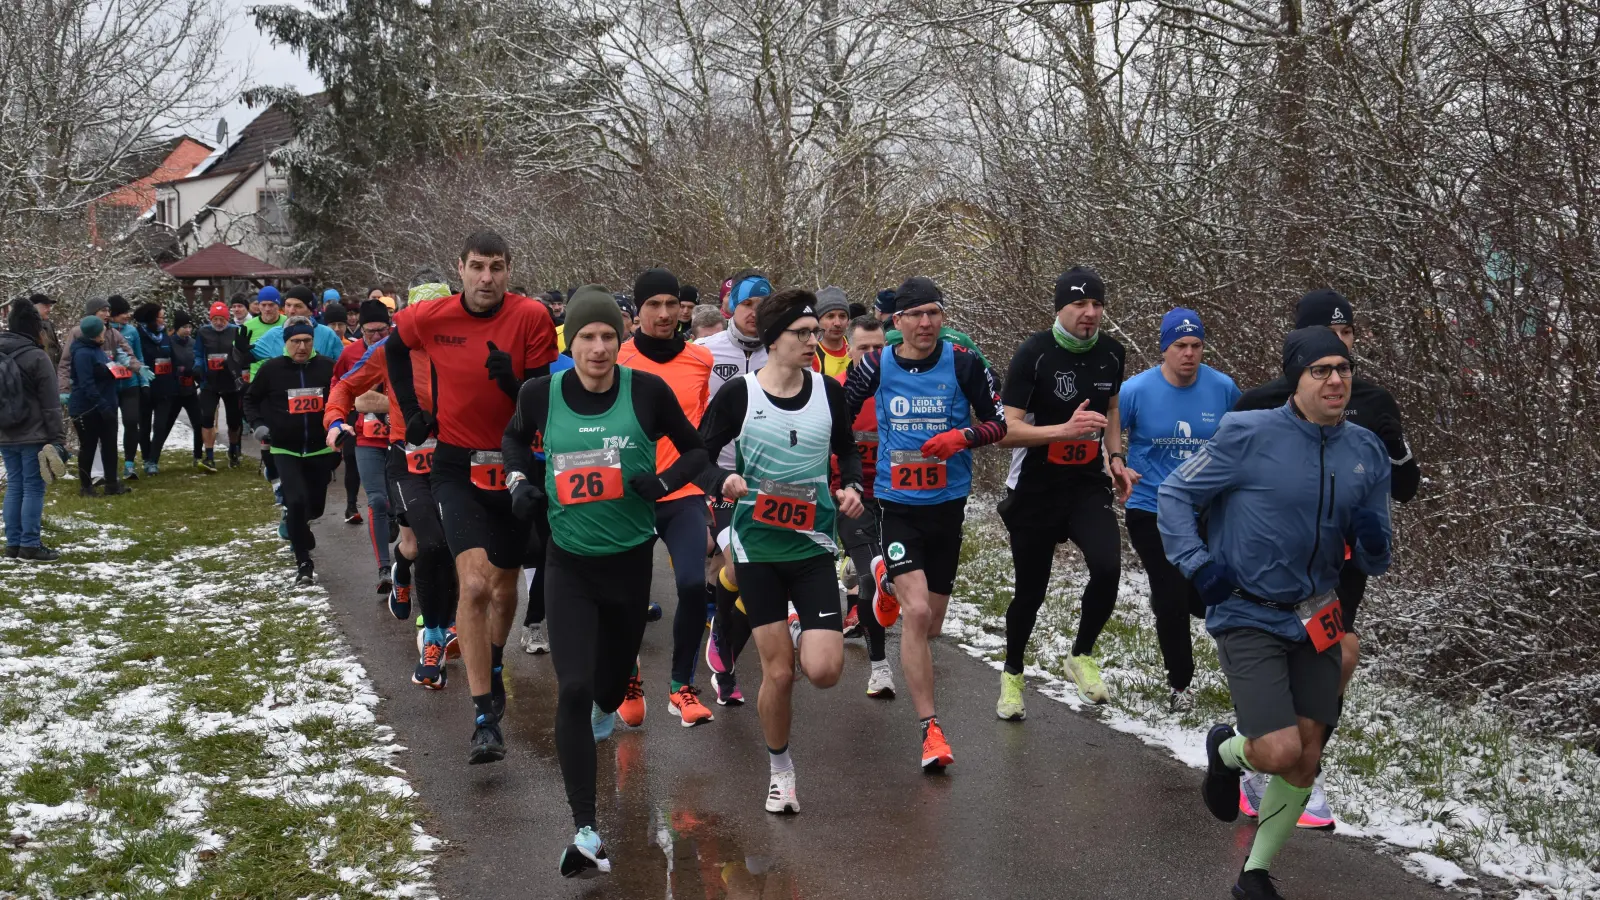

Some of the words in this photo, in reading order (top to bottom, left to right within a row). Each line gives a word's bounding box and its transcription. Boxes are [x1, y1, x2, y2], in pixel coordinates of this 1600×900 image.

[1057, 375, 1073, 396] TSG
[294, 398, 319, 411] 220
[891, 423, 909, 431] TSG
[912, 423, 924, 431] 08
[926, 423, 947, 431] Roth
[602, 435, 630, 449] TSV
[1062, 443, 1087, 462] 36
[569, 471, 604, 498] 26
[899, 467, 939, 486] 215
[761, 499, 808, 526] 205
